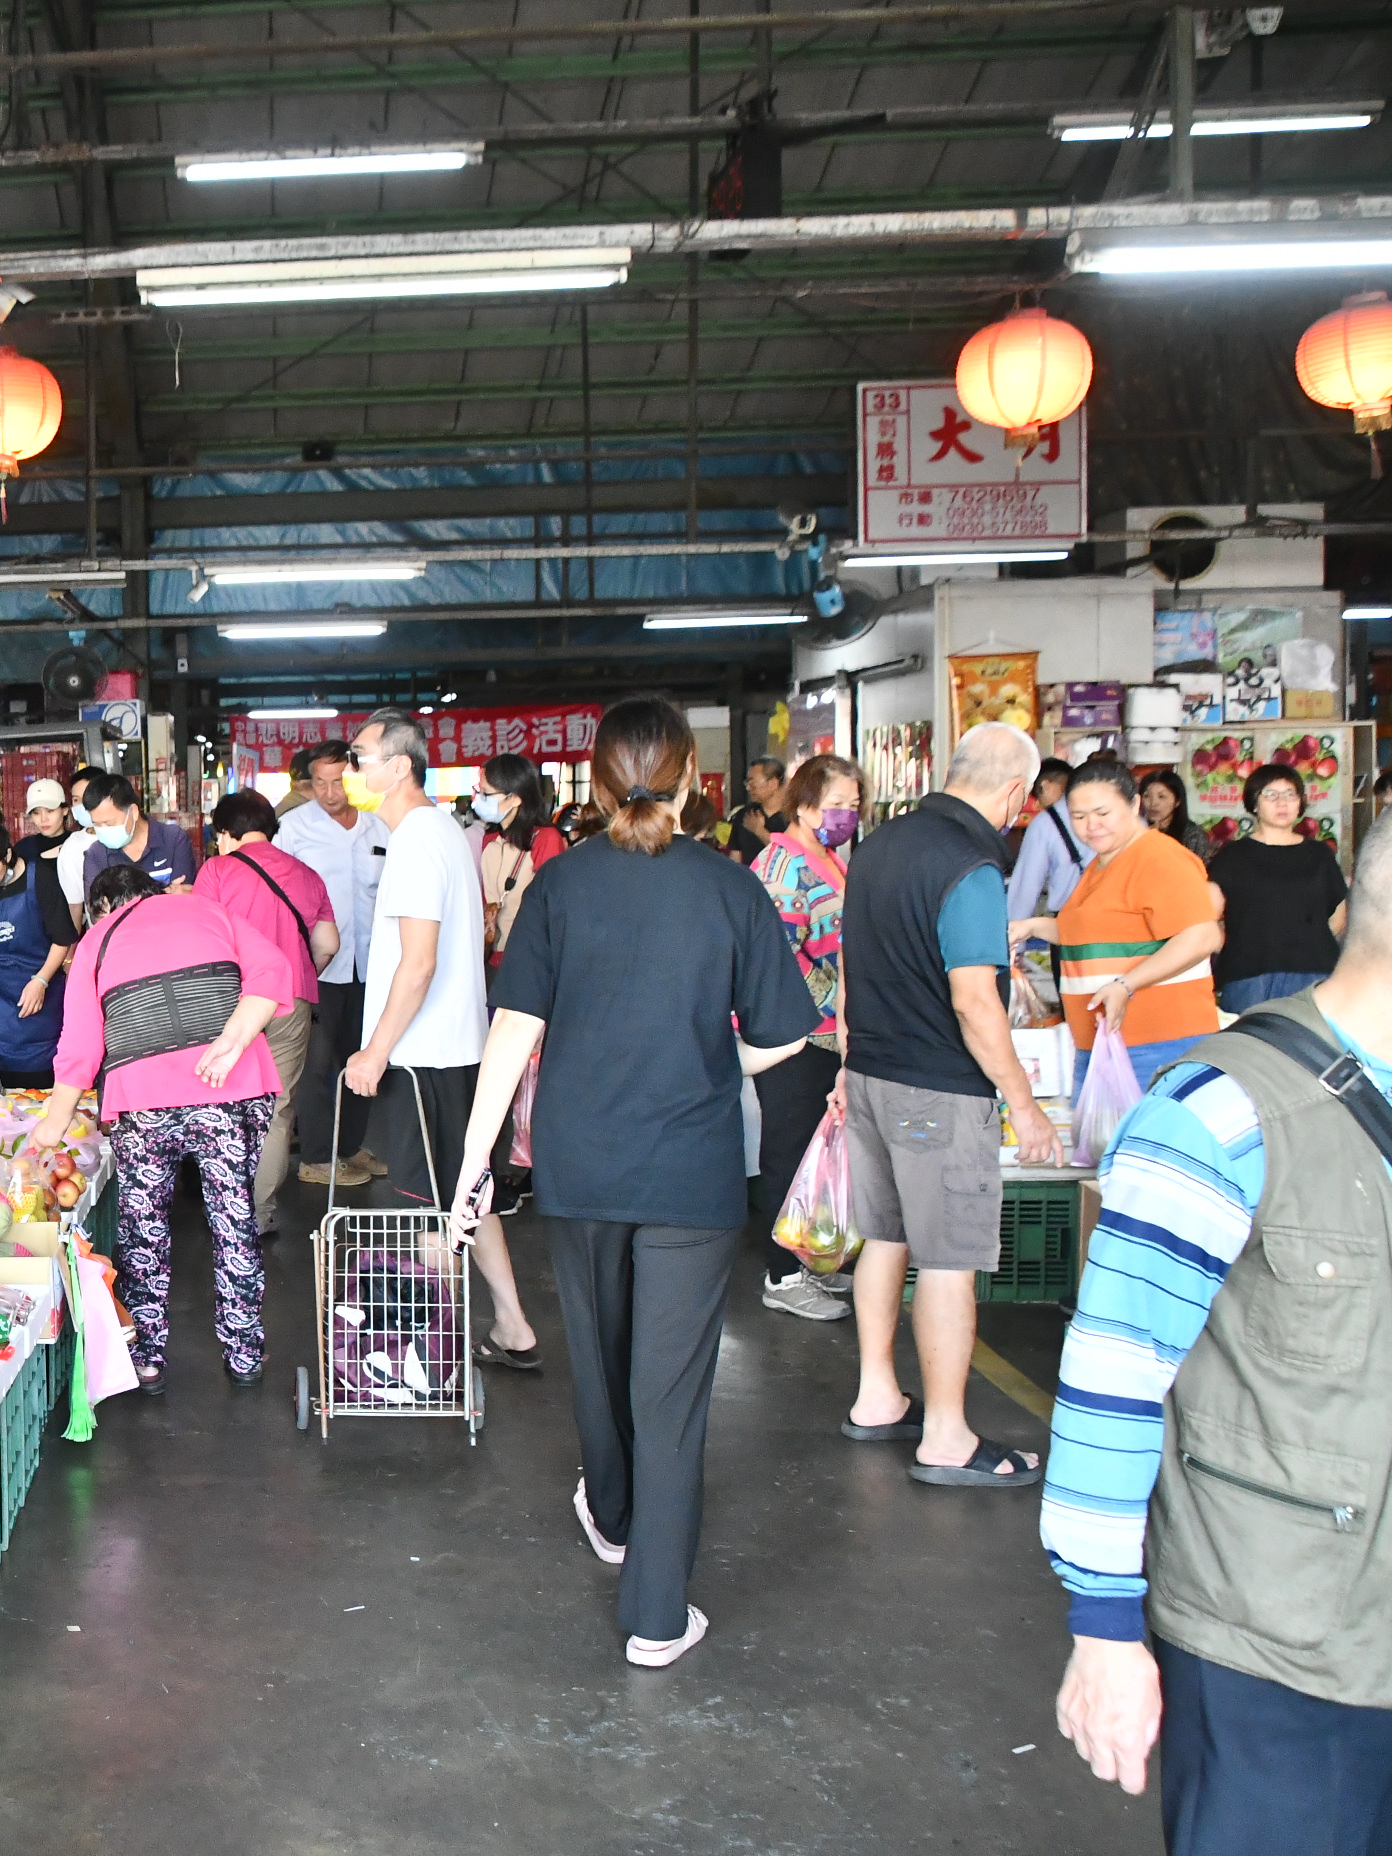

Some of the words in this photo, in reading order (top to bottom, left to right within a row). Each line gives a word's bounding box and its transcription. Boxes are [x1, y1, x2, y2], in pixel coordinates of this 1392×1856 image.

[872, 392, 901, 410] 33
[460, 713, 597, 758] 義診活動
